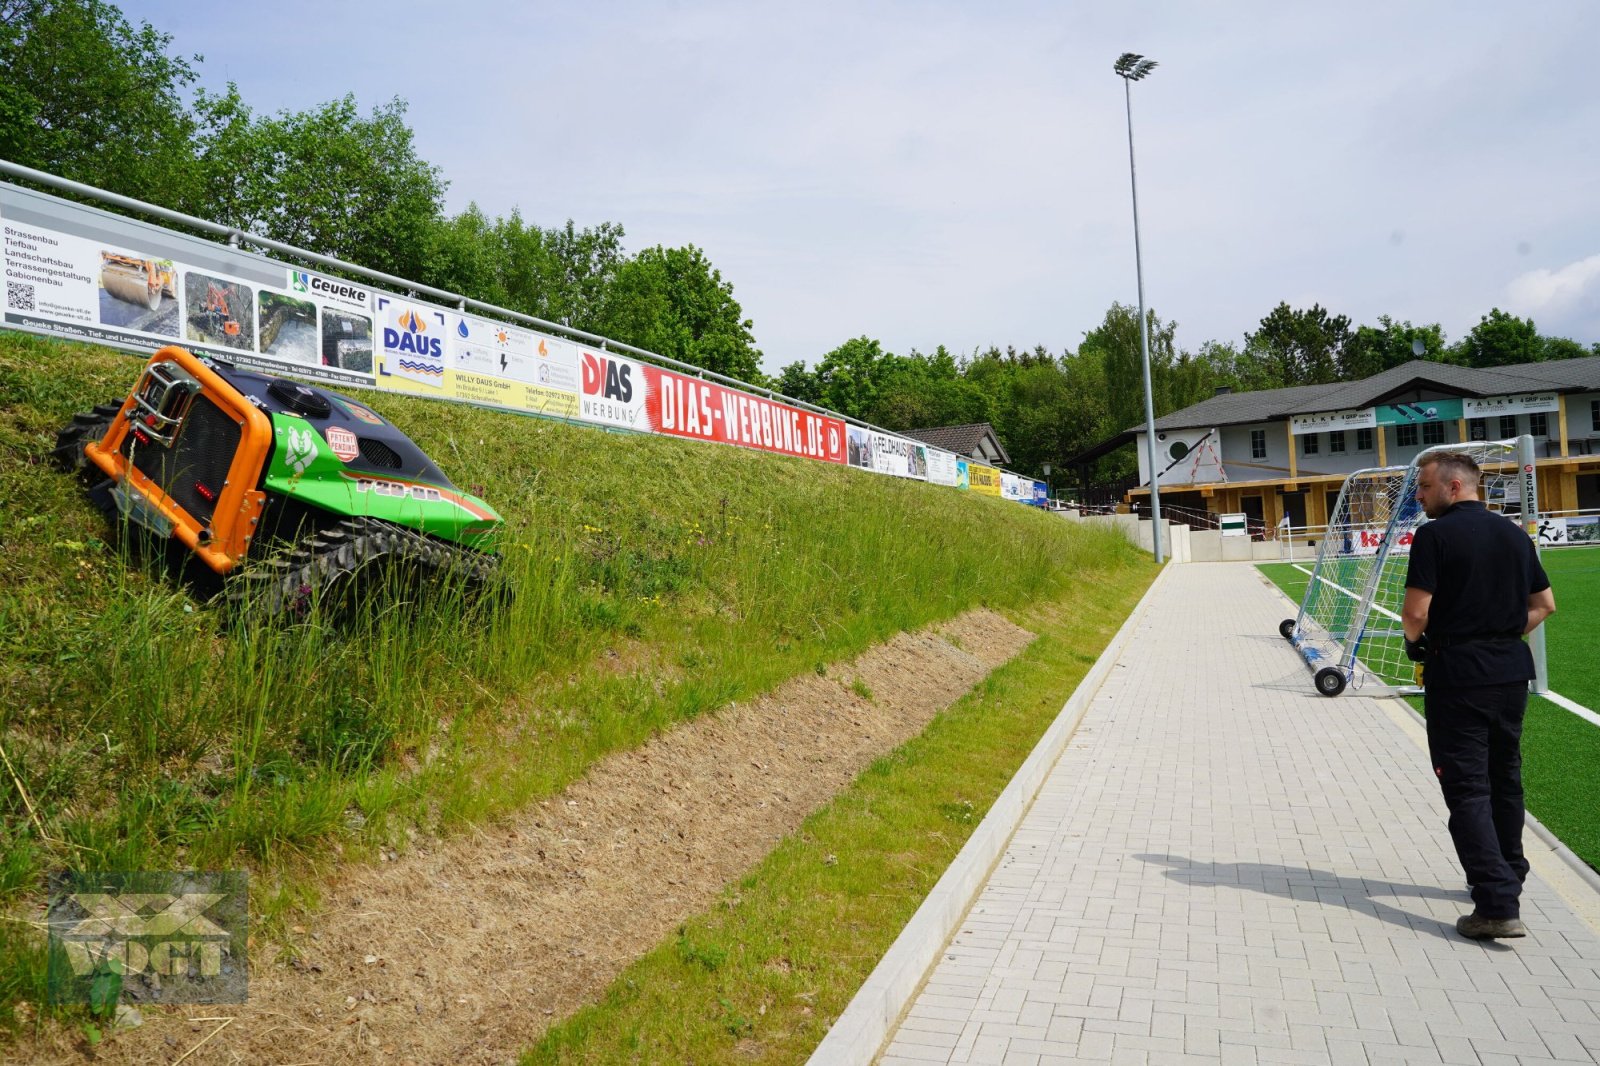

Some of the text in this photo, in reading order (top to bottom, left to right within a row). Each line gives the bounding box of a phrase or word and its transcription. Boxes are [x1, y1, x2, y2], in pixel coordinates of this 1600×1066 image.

[5, 226, 59, 246] Strassenbau
[5, 237, 37, 251] Tiefbau
[5, 248, 74, 269] Landschaftsbau
[5, 258, 92, 283] Terrassengestaltung
[6, 269, 63, 287] Gabionenbau
[311, 277, 366, 302] Geueke
[22, 319, 52, 330] Geueke
[88, 329, 104, 339] Tief-
[384, 327, 442, 357] DAUS
[456, 374, 475, 383] WILLY
[476, 377, 493, 387] DAUS
[493, 380, 511, 390] GmbH
[581, 352, 633, 404] DIAS
[583, 400, 634, 423] WERBUNG
[1467, 398, 1513, 408] FALKE
[660, 374, 825, 457] DIAS-WERBUNG.DE
[1294, 416, 1336, 424] FALKE
[877, 436, 907, 458] FELDHAUS
[1524, 473, 1536, 515] SCHÄPER
